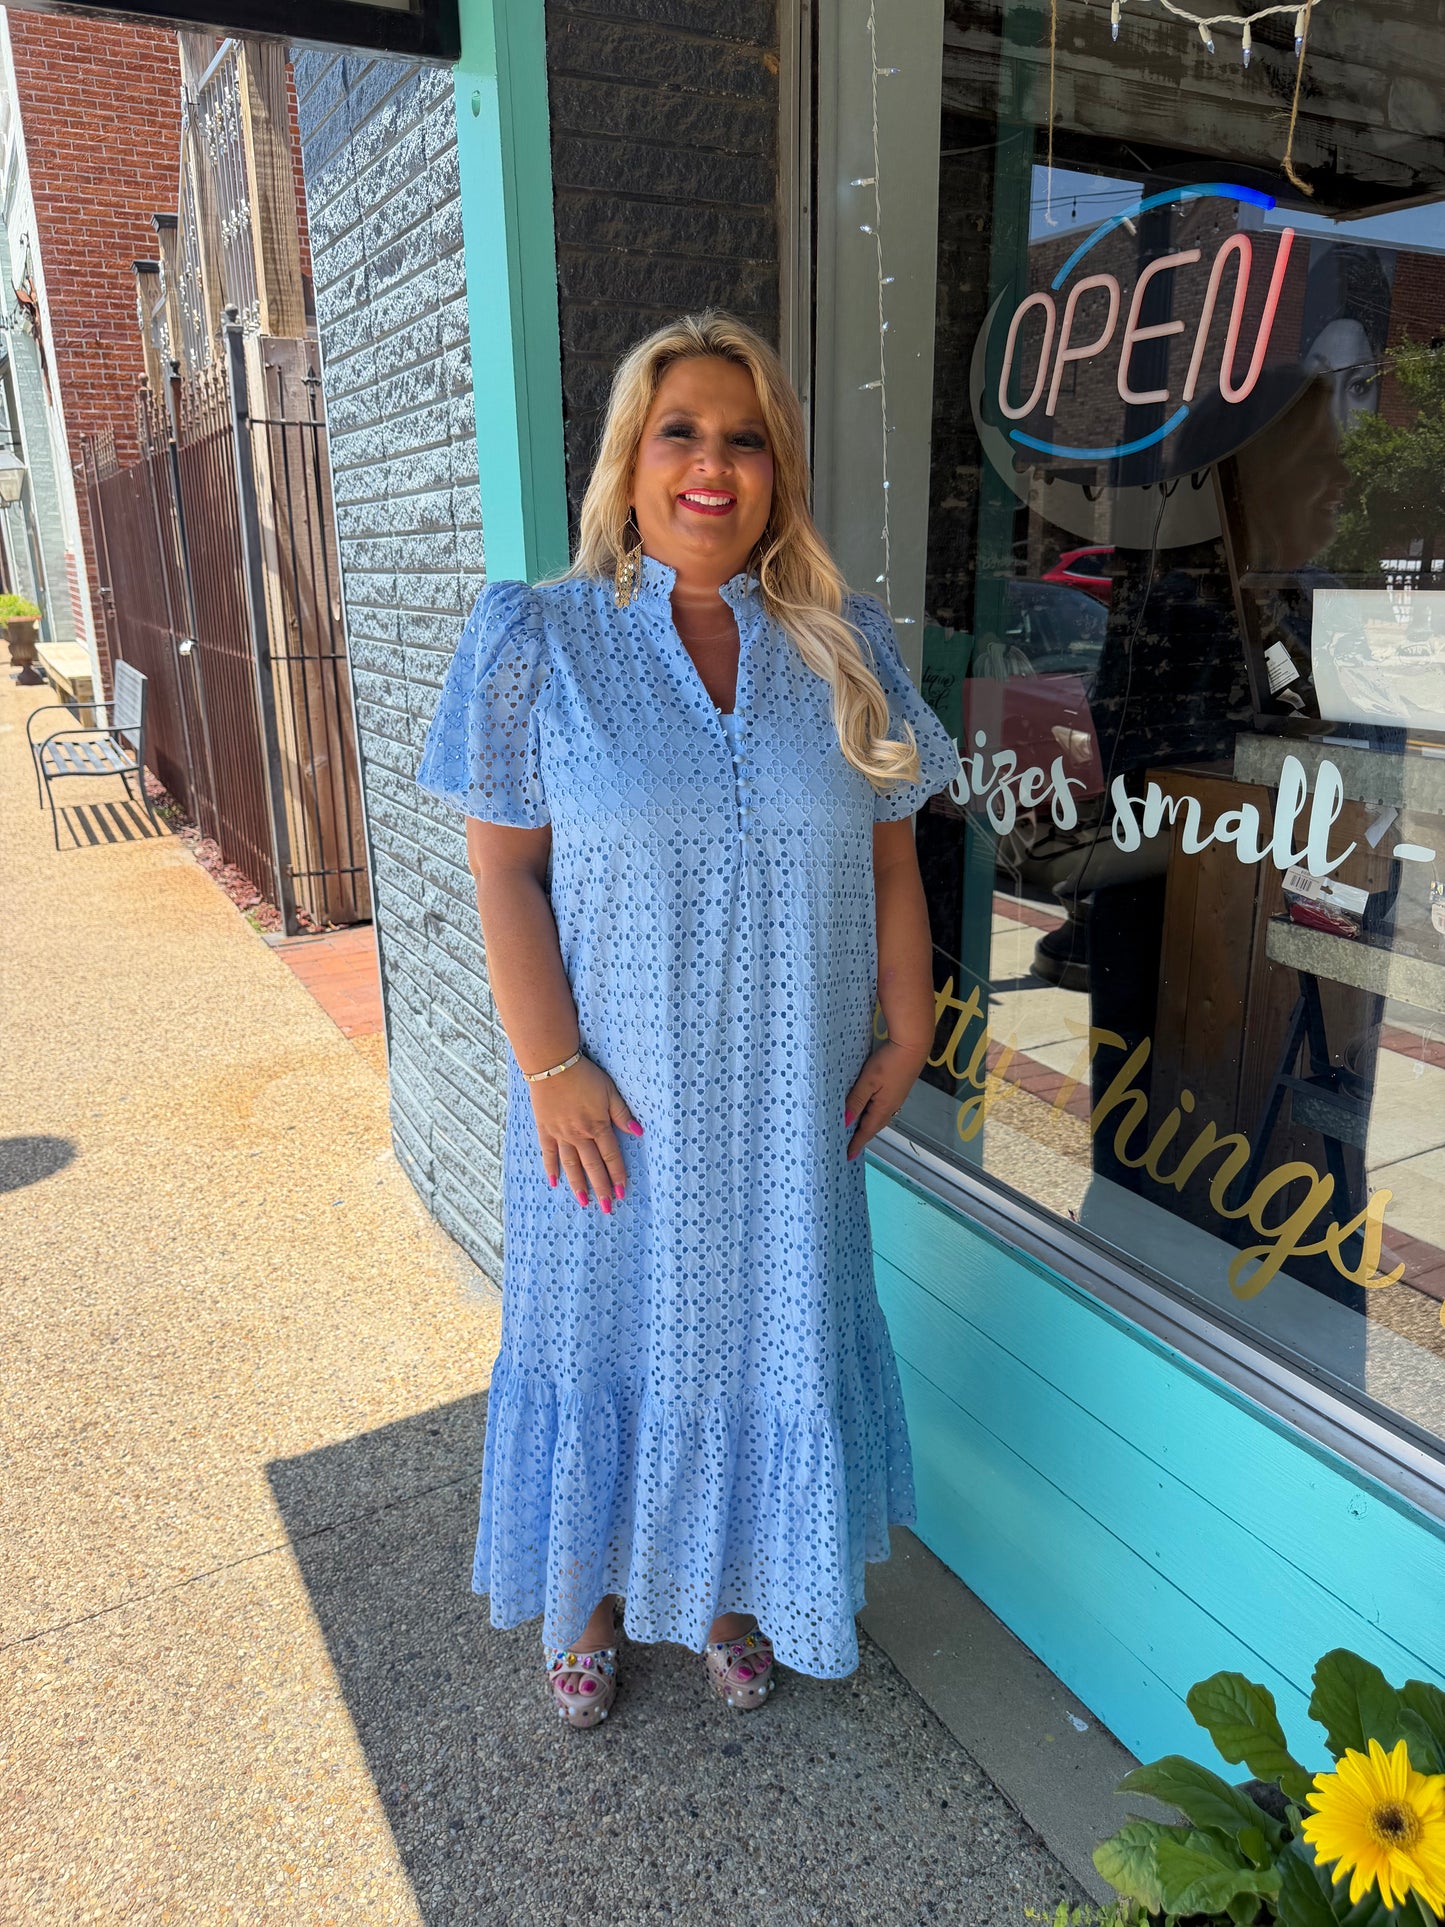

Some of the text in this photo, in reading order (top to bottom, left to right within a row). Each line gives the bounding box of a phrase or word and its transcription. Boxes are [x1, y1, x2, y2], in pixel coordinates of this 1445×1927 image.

[999, 227, 1295, 419] OPEN
[950, 729, 1088, 836] sizes
[1111, 755, 1357, 877] small
[1052, 1017, 1406, 1300] Things
